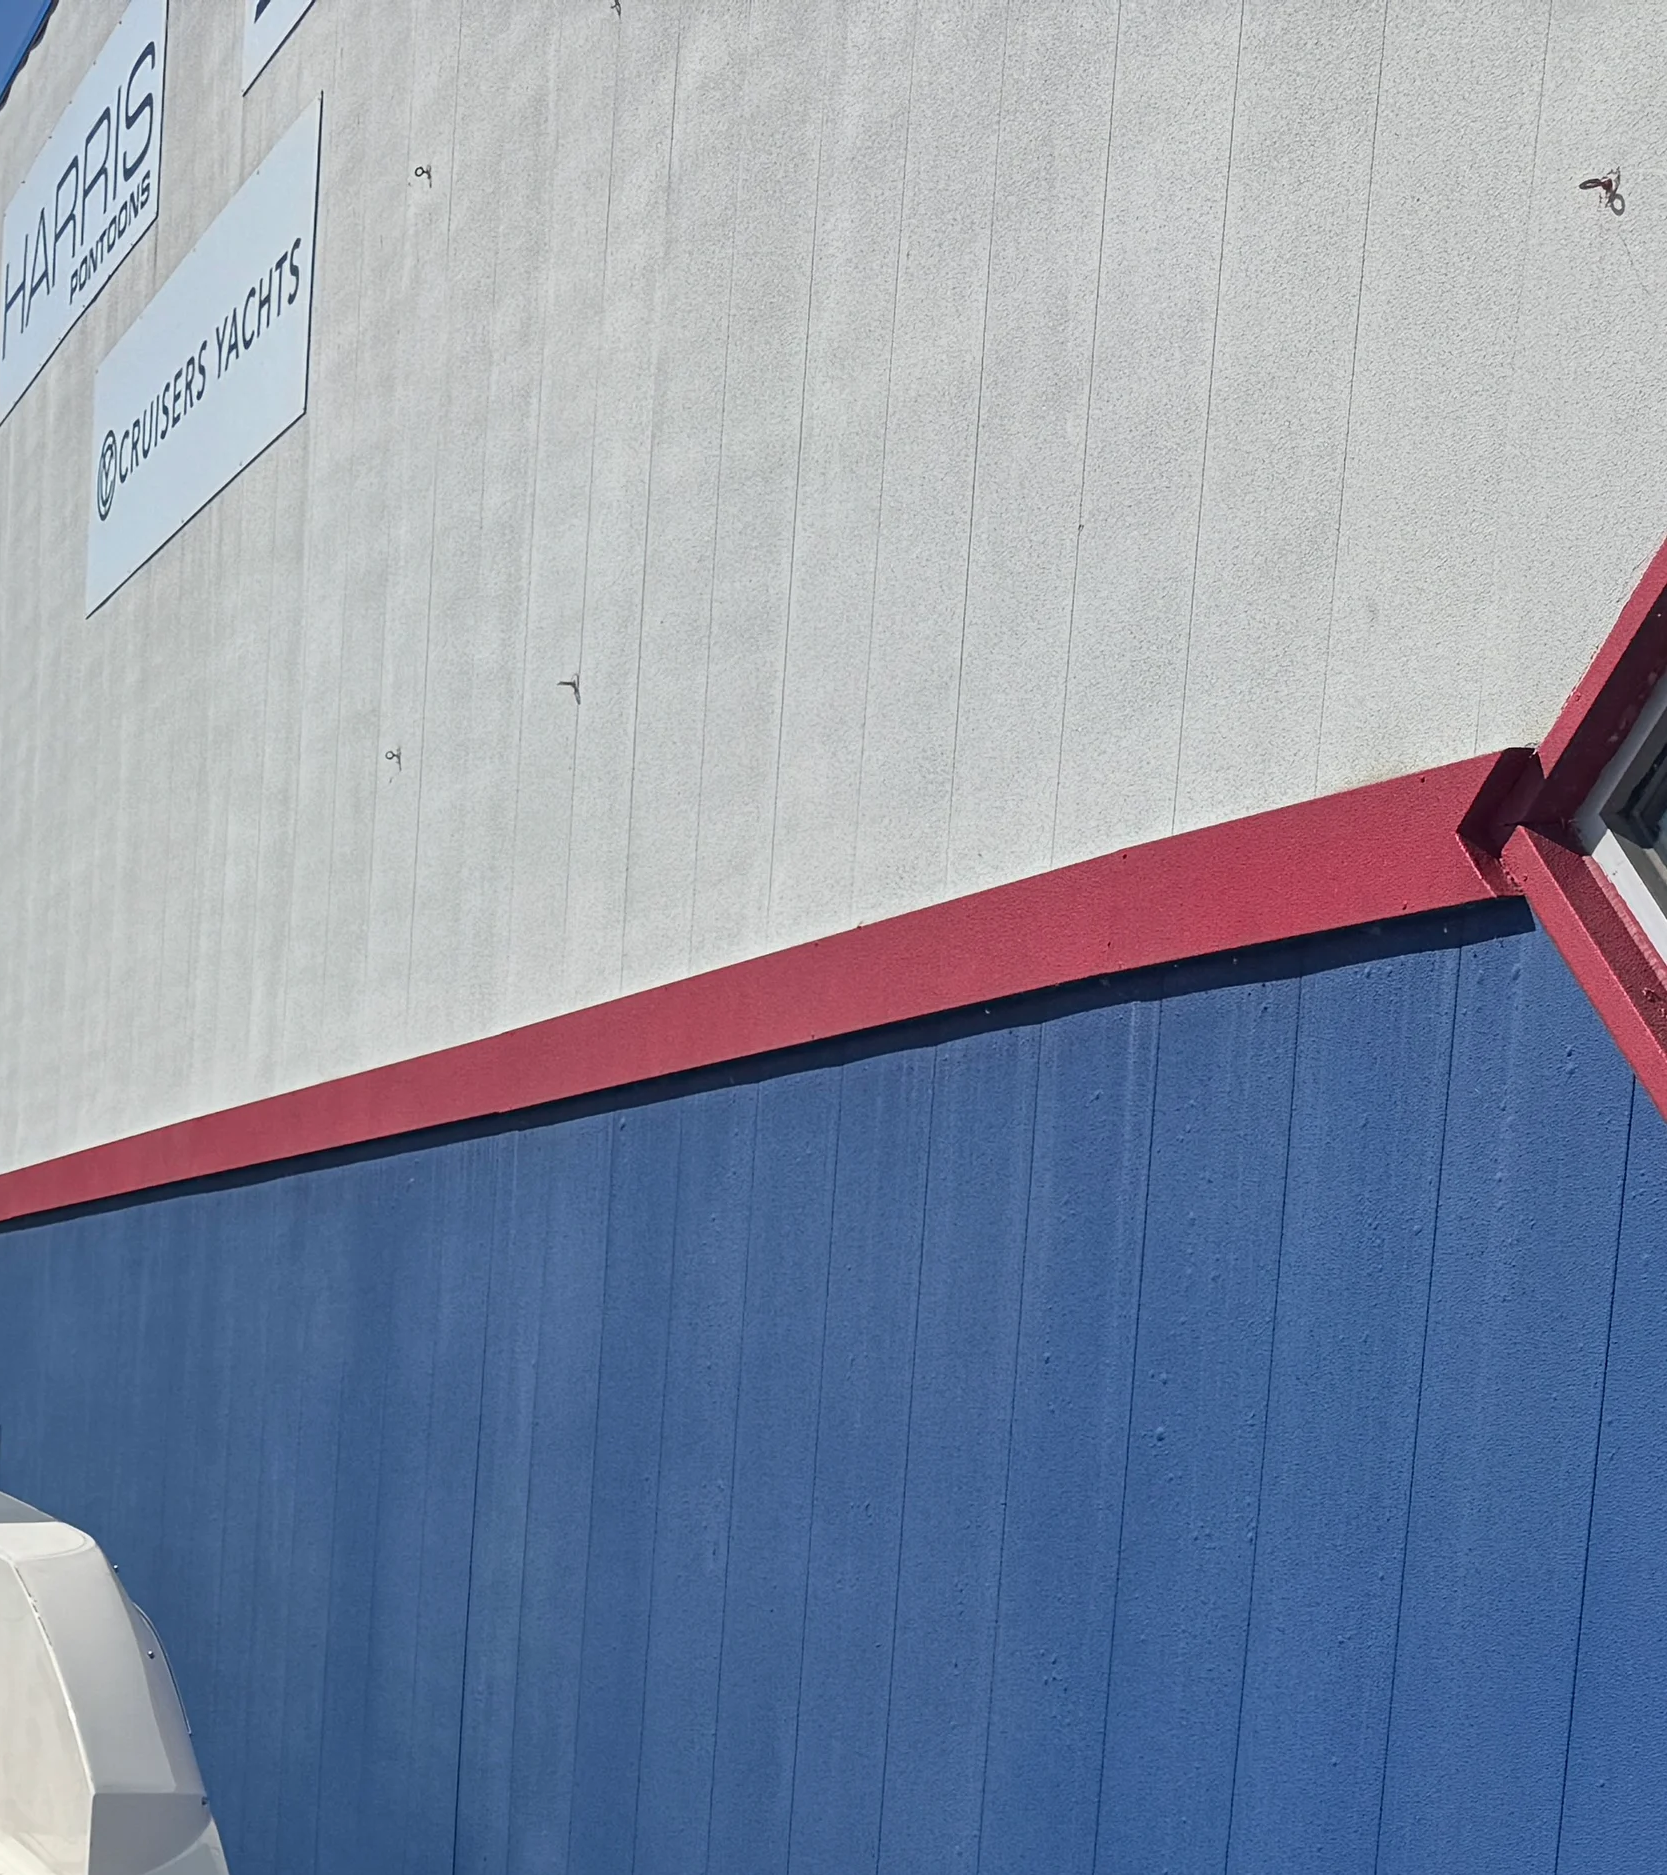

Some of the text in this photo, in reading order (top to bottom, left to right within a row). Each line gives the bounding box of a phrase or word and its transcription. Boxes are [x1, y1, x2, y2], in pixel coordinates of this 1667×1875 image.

[1, 41, 155, 361] HARRIS
[69, 169, 151, 305] PONTOONS
[118, 237, 301, 484] CRUISERS YACHTS
